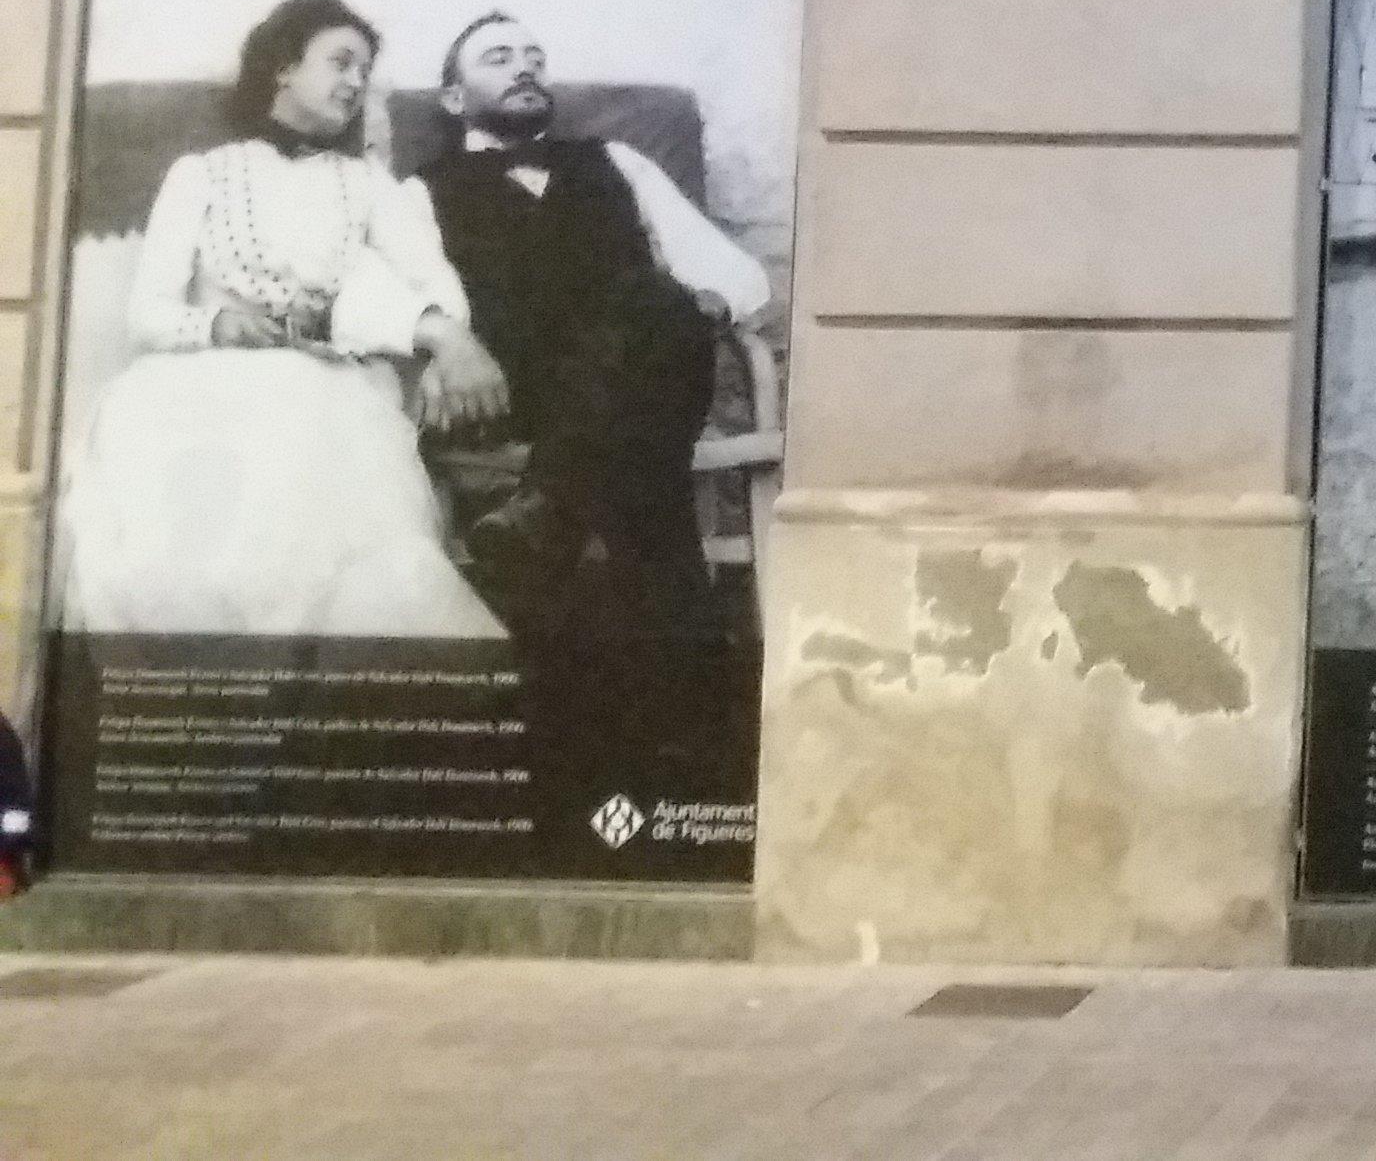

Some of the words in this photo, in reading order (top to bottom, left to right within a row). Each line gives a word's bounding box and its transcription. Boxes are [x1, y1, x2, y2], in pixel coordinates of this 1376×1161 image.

[653, 800, 756, 823] Ajuntament
[652, 822, 675, 841] de
[681, 821, 756, 844] Figueres
